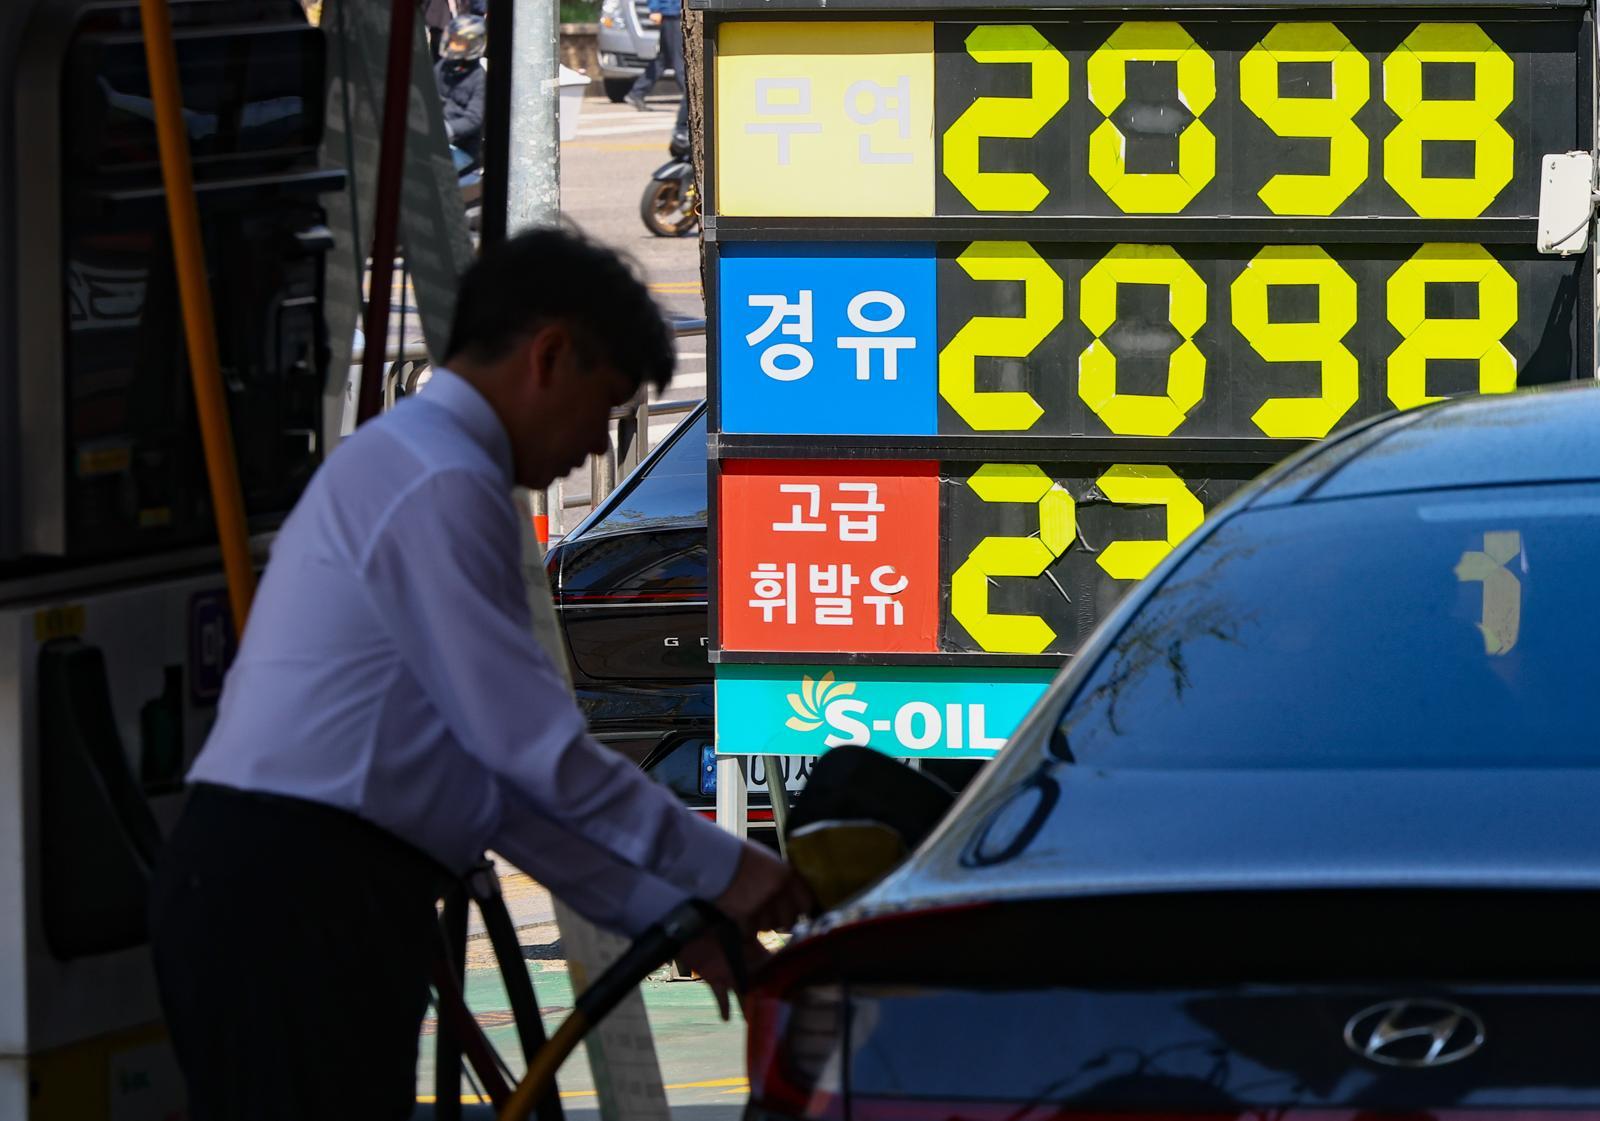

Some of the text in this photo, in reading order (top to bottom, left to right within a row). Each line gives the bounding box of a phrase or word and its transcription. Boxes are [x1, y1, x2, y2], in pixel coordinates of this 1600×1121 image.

[744, 21, 1515, 220] 무연 2098
[745, 241, 1519, 437] 경유 2098
[772, 482, 885, 542] 고급
[748, 562, 909, 626] 휘발유
[824, 699, 1008, 750] S-OIL
